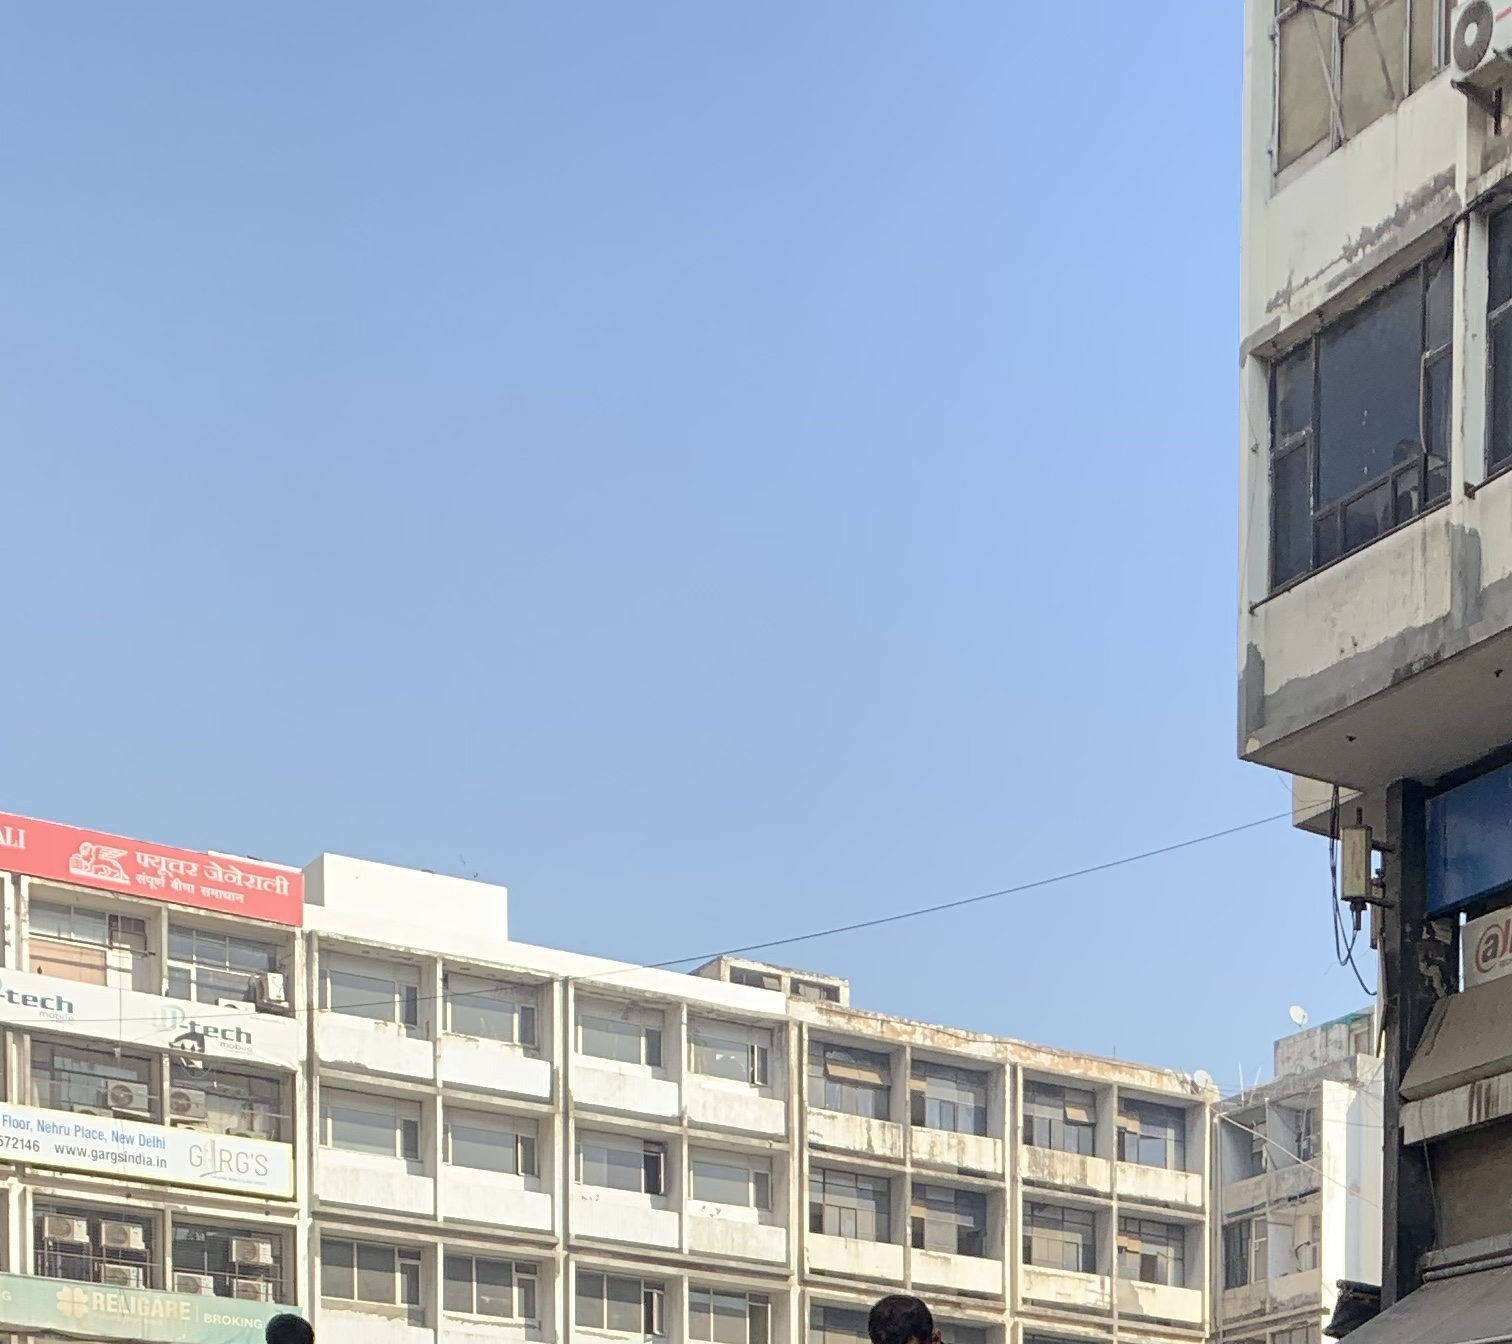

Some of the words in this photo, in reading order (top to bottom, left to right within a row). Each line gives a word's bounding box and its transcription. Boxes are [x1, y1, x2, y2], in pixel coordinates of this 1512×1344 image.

[2, 1114, 33, 1133] Floor,
[37, 1121, 70, 1138] Nehru
[74, 1125, 107, 1143] Place,
[111, 1130, 135, 1146] New
[138, 1133, 166, 1150] Delhi
[54, 1142, 167, 1168] www.gargsindia.in
[92, 1292, 191, 1321] RELIGARE
[204, 1313, 263, 1330] BROKING
